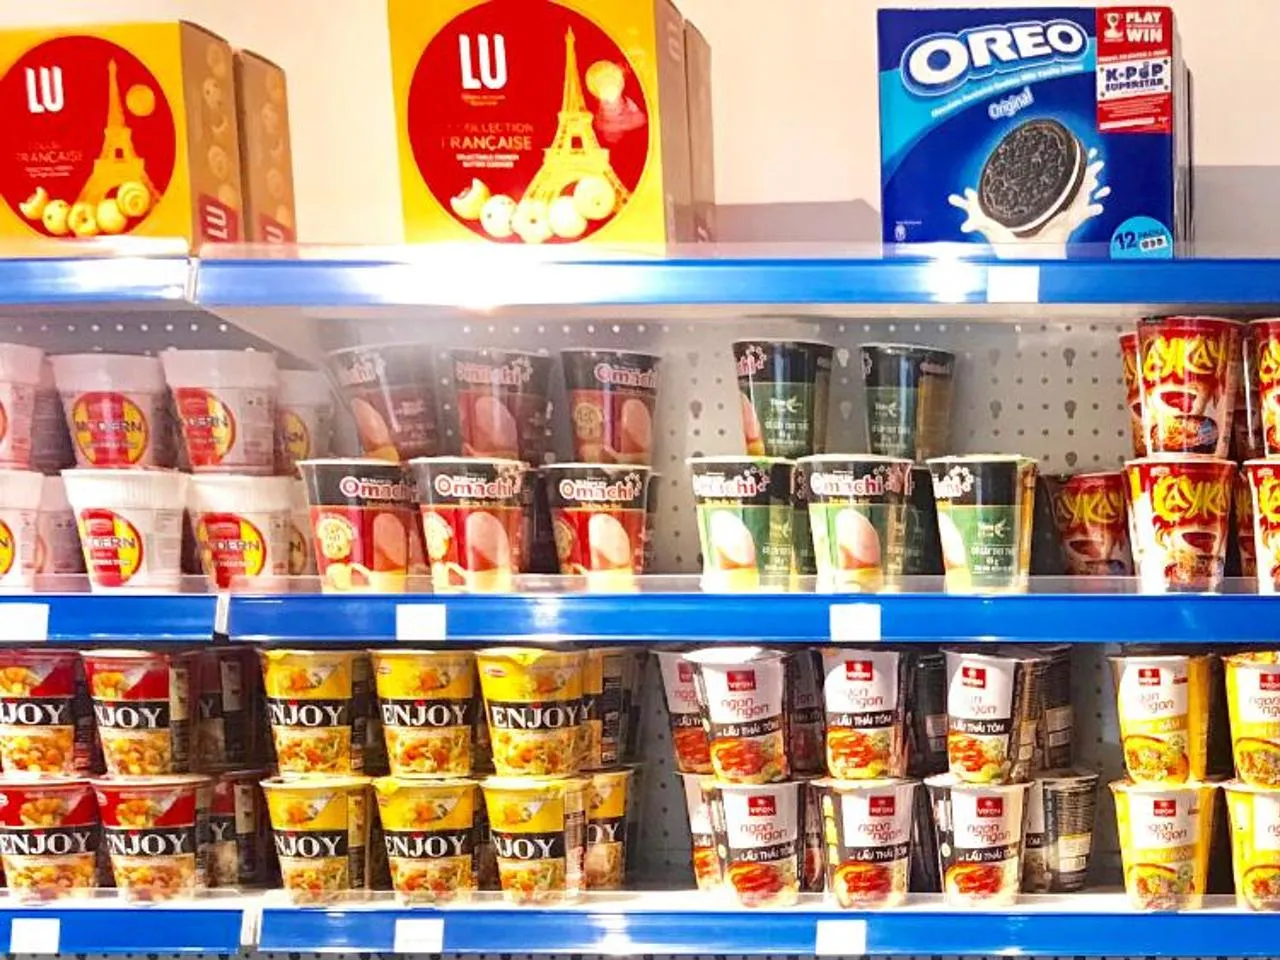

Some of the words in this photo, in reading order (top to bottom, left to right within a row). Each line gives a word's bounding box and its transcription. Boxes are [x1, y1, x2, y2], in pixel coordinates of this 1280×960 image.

[1126, 12, 1161, 24] PLAY
[1127, 29, 1162, 43] WIN
[459, 34, 507, 89] LU
[909, 22, 1083, 85] OREO
[26, 66, 64, 113] LU
[989, 87, 1033, 119] Original
[206, 206, 227, 239] LU
[1114, 232, 1137, 253] 12
[435, 474, 515, 500] Omachi
[560, 478, 636, 501] Omachi
[382, 703, 468, 727] ENJOY
[492, 703, 582, 729] ENJOY
[385, 836, 467, 858] ENJOY
